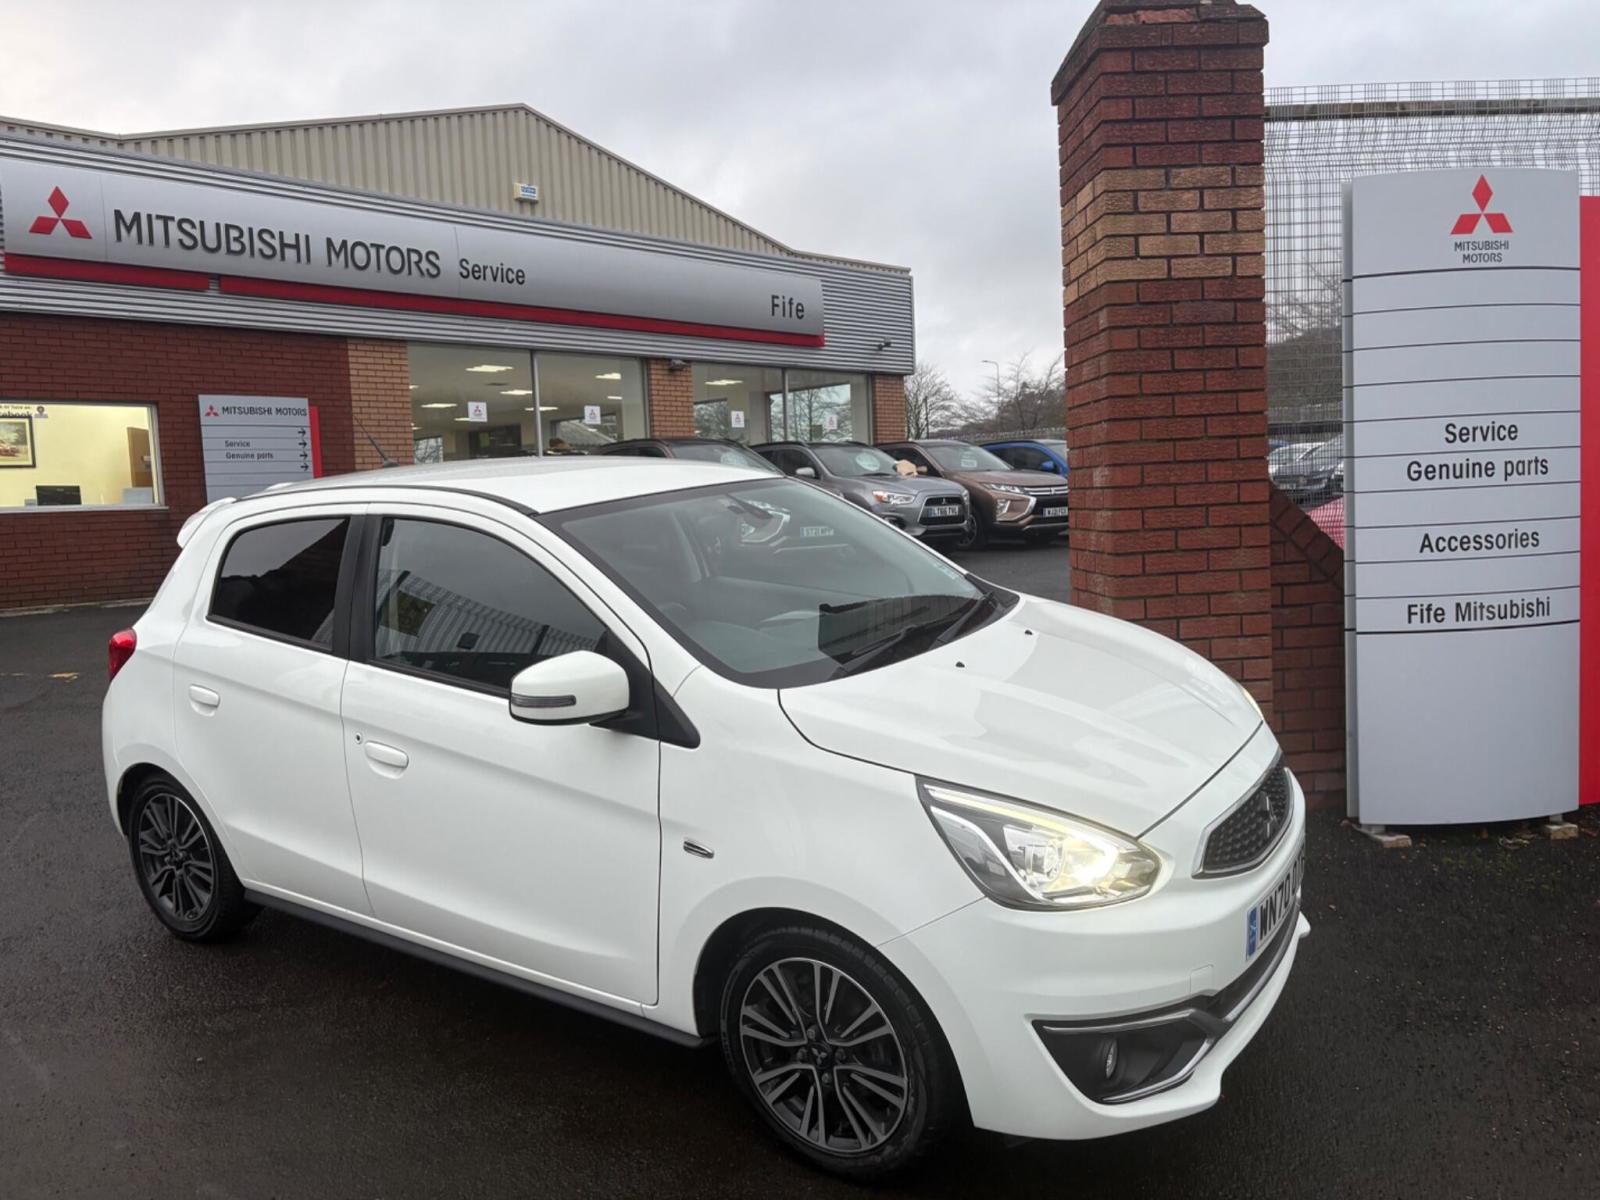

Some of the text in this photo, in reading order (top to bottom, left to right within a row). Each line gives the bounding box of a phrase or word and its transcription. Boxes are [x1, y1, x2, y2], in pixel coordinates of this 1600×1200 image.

[114, 208, 526, 286] MITSUBISHI MOTORS Service
[1454, 240, 1509, 252] MITSUBISHI
[1462, 252, 1503, 264] MOTORS
[771, 294, 805, 320] Fife
[222, 406, 308, 417] MITSUBISHI MOTORS
[224, 440, 251, 448] Service
[1444, 421, 1519, 444] Service
[225, 452, 255, 460] Genuine
[1406, 456, 1549, 482] Genuine parts
[1419, 529, 1540, 554] Accessories
[1407, 597, 1551, 625] Fife Mitsubishi
